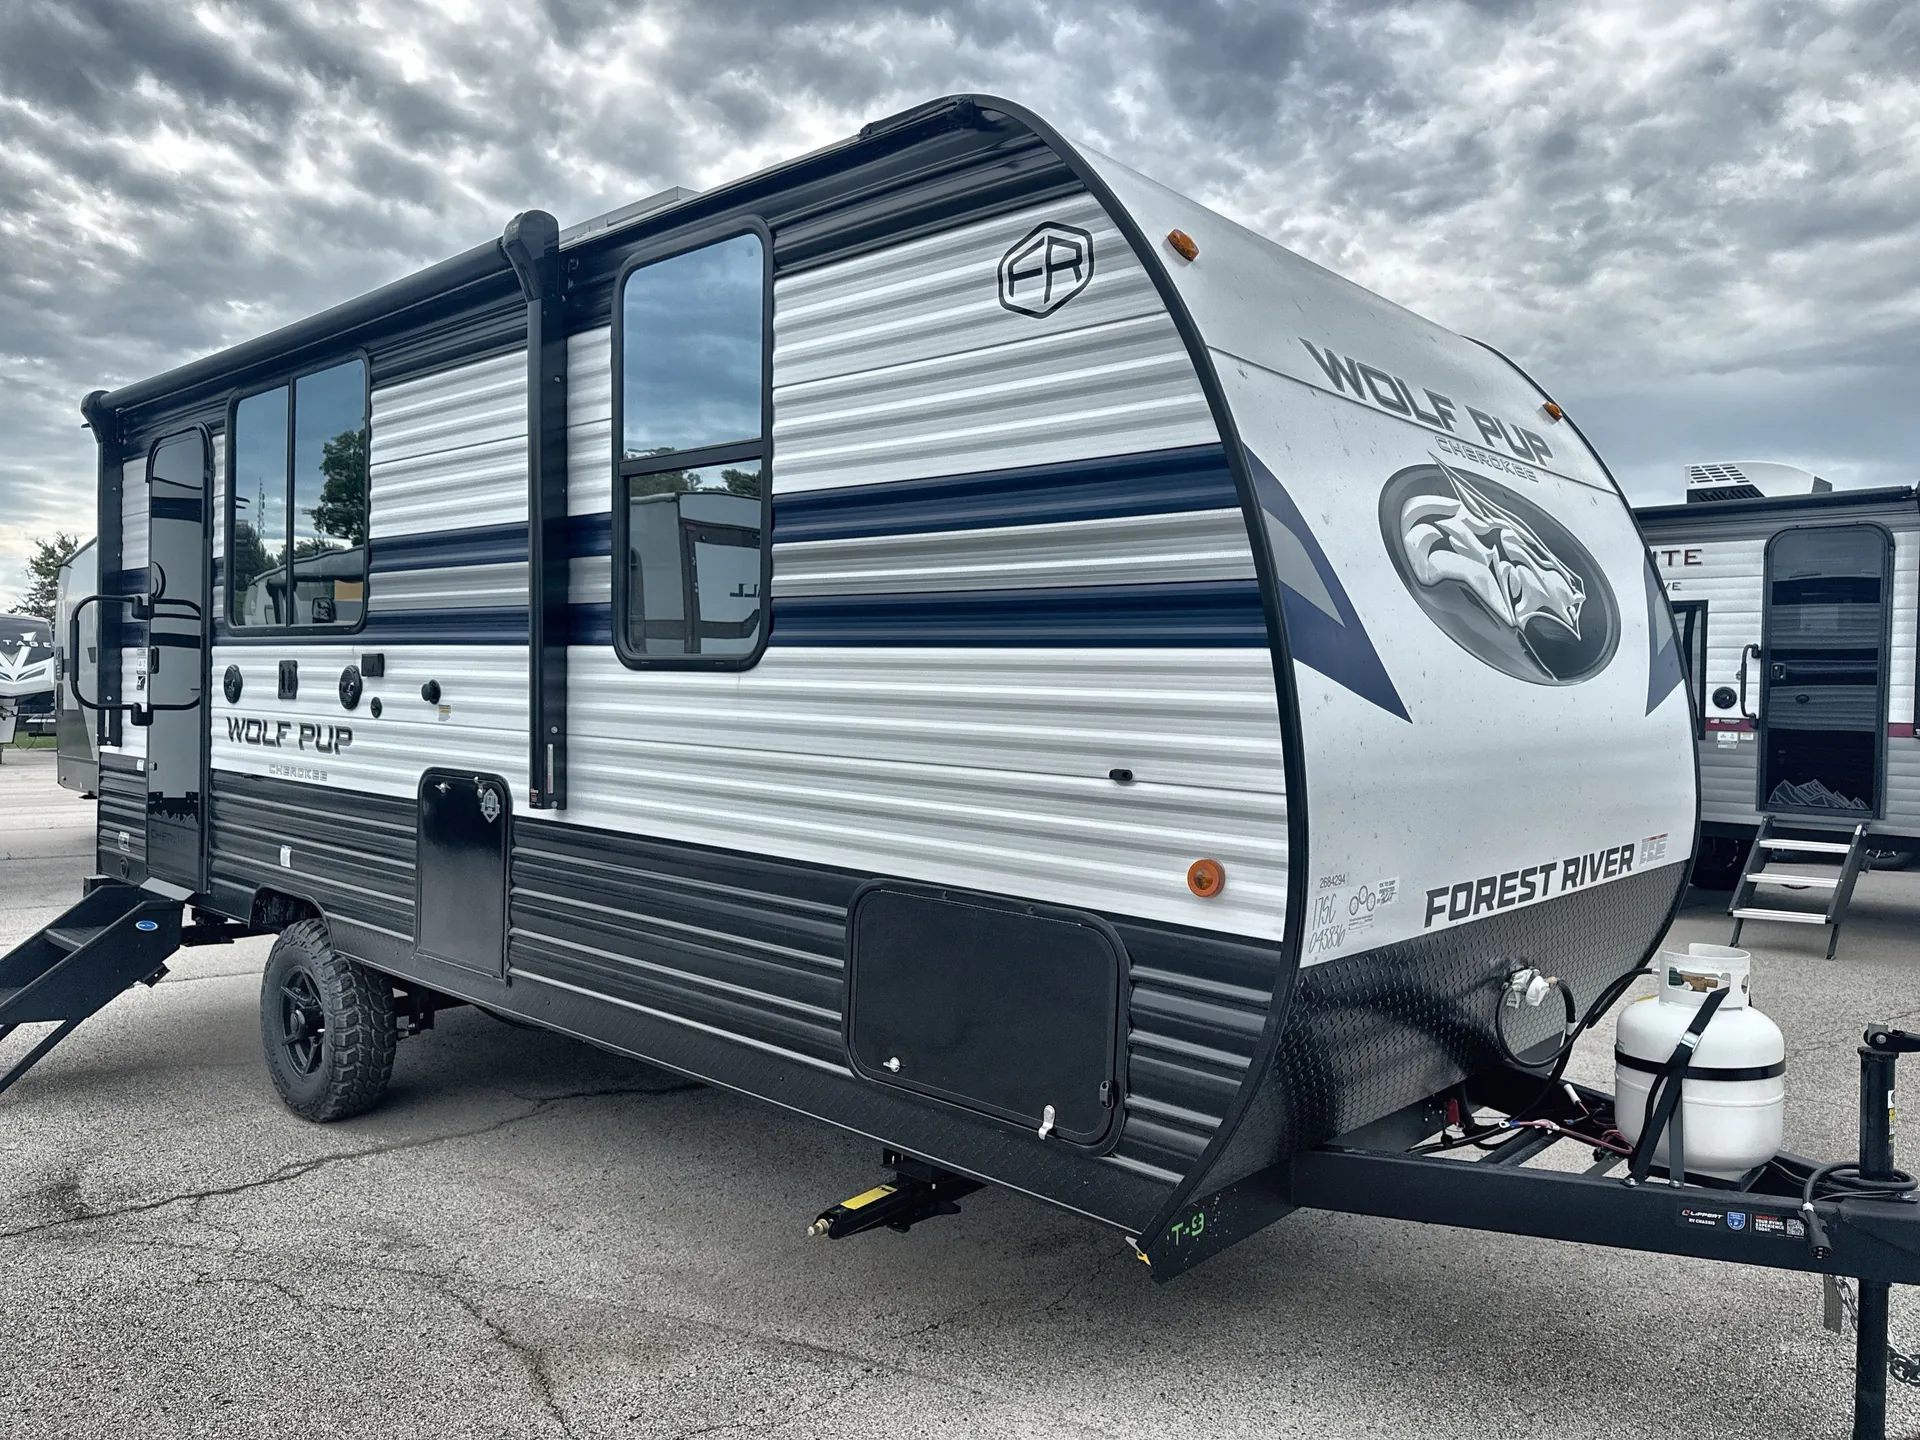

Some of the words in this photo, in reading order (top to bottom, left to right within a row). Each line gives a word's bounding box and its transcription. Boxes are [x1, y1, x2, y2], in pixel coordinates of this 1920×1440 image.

[1297, 336, 1457, 433] WOLF
[1464, 404, 1554, 467] PUP
[1434, 435, 1539, 483] CHEROKEE
[225, 716, 292, 748] WOLF
[298, 722, 353, 755] PUP
[268, 763, 328, 782] CHEROKEE
[1319, 873, 1346, 889] 2684294
[1423, 860, 1558, 929] FOREST
[1560, 843, 1636, 892] RIVER
[1695, 1218, 1716, 1226] CHASSIS
